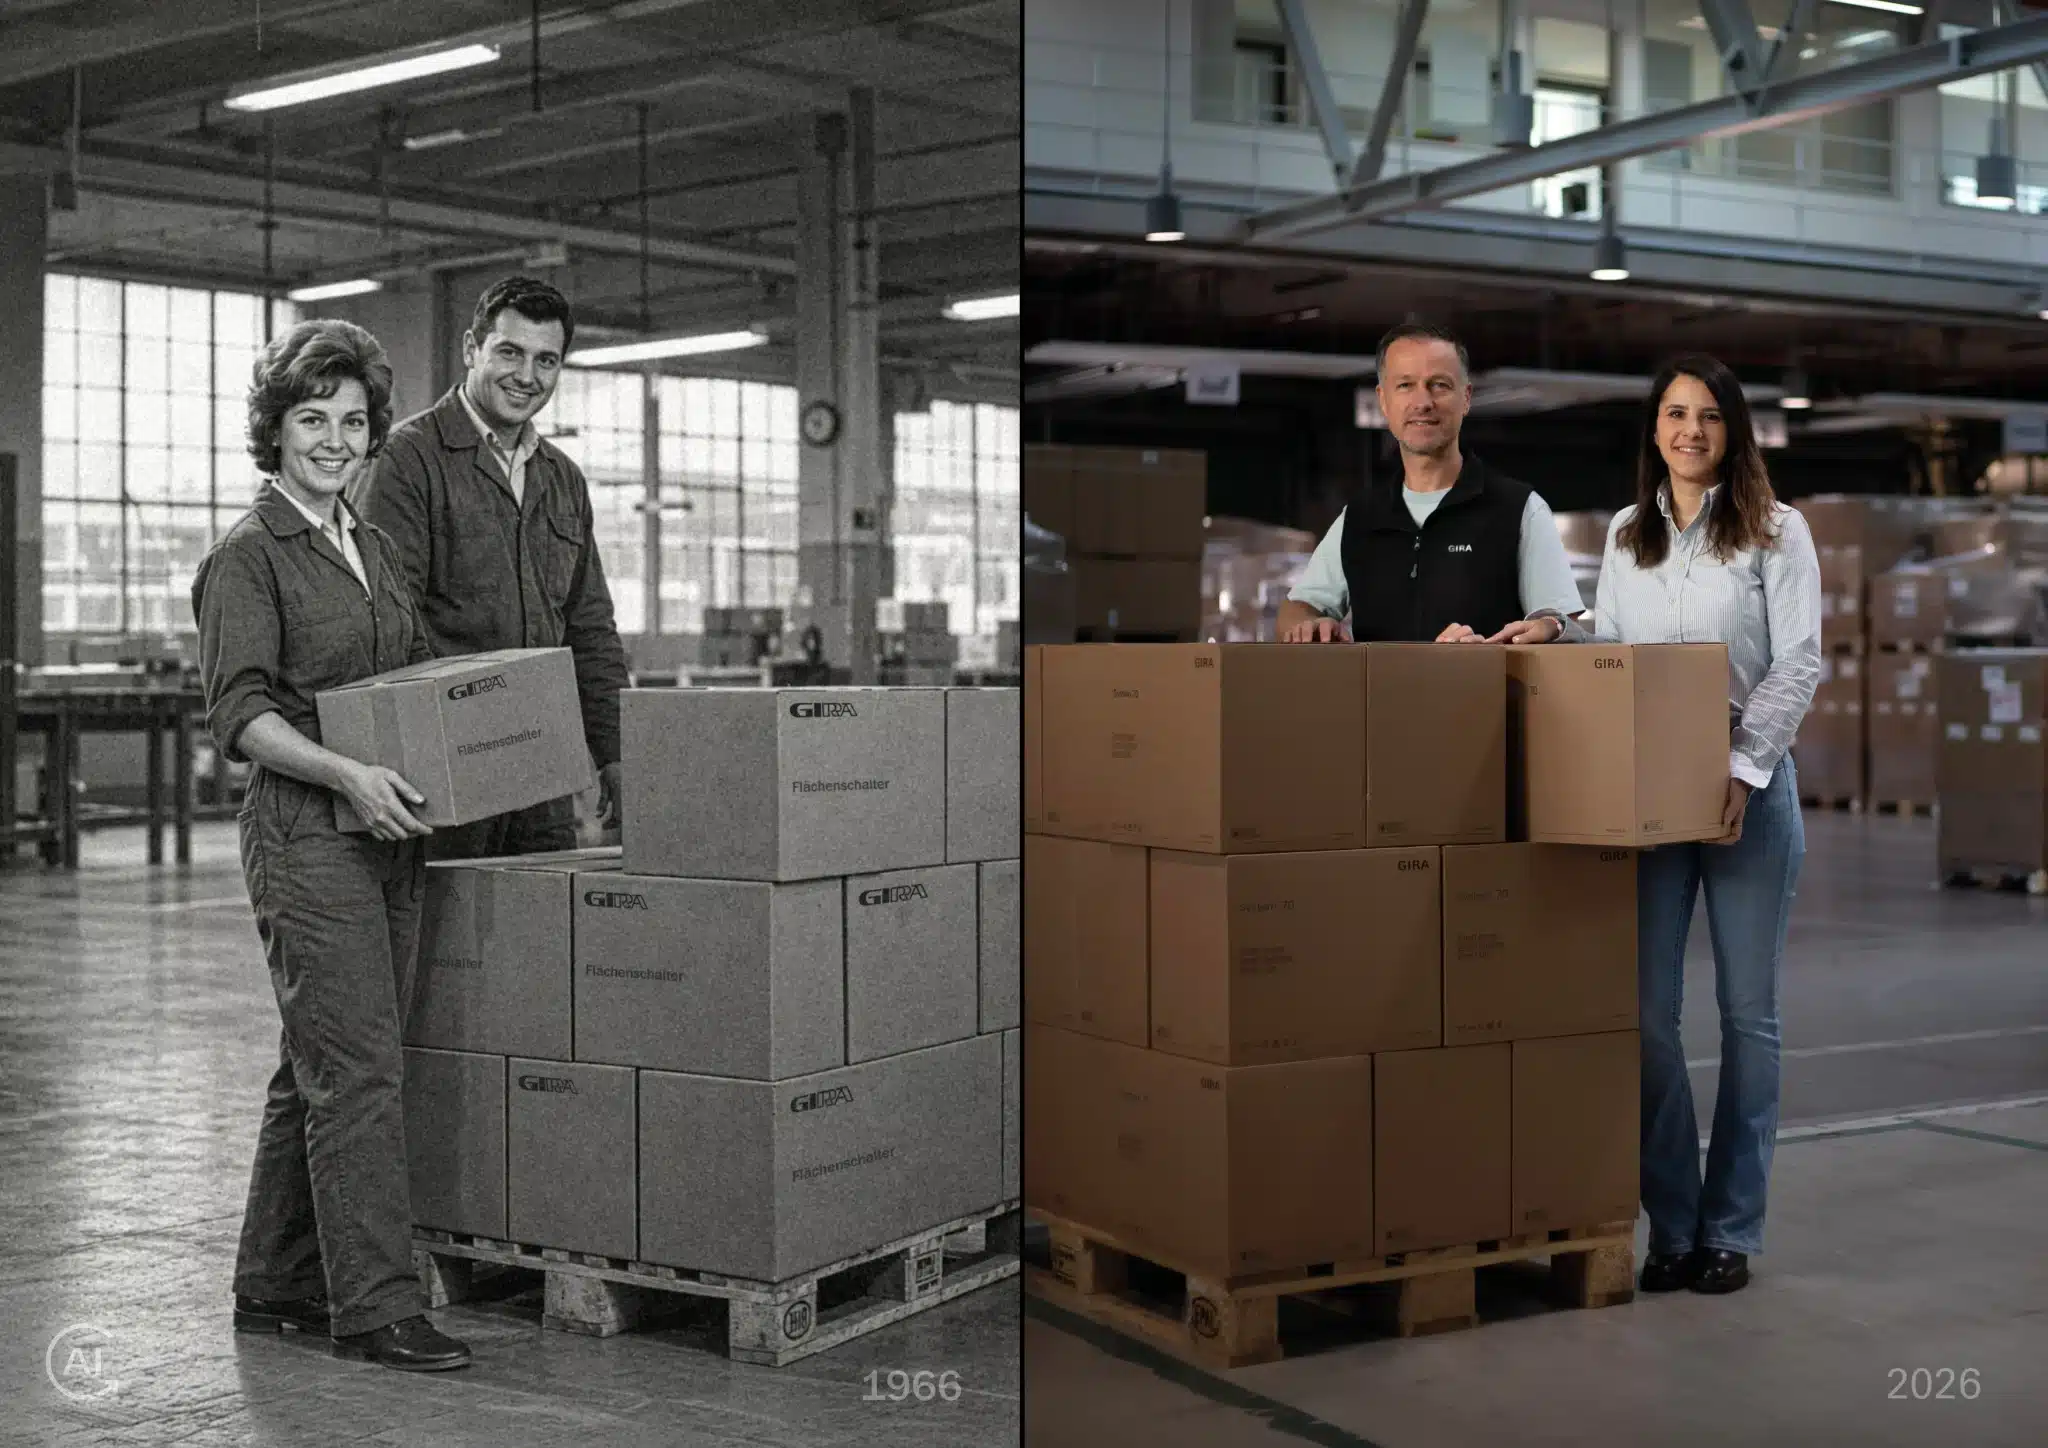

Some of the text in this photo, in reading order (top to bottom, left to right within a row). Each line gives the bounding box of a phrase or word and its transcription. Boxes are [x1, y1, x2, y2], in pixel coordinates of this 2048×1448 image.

[1447, 544, 1472, 553] GIRA
[1194, 657, 1214, 668] GIRA
[1594, 657, 1624, 669] GIRA
[447, 673, 508, 701] GIRA
[788, 702, 859, 718] GIRA
[791, 779, 891, 793] Flächenschalter
[1600, 850, 1630, 862] GIRA
[1397, 858, 1431, 872] GIRA
[583, 890, 649, 910] GIRA
[857, 883, 930, 907] GIRA
[517, 1074, 580, 1095] GIRA
[790, 1085, 855, 1113] GIRA
